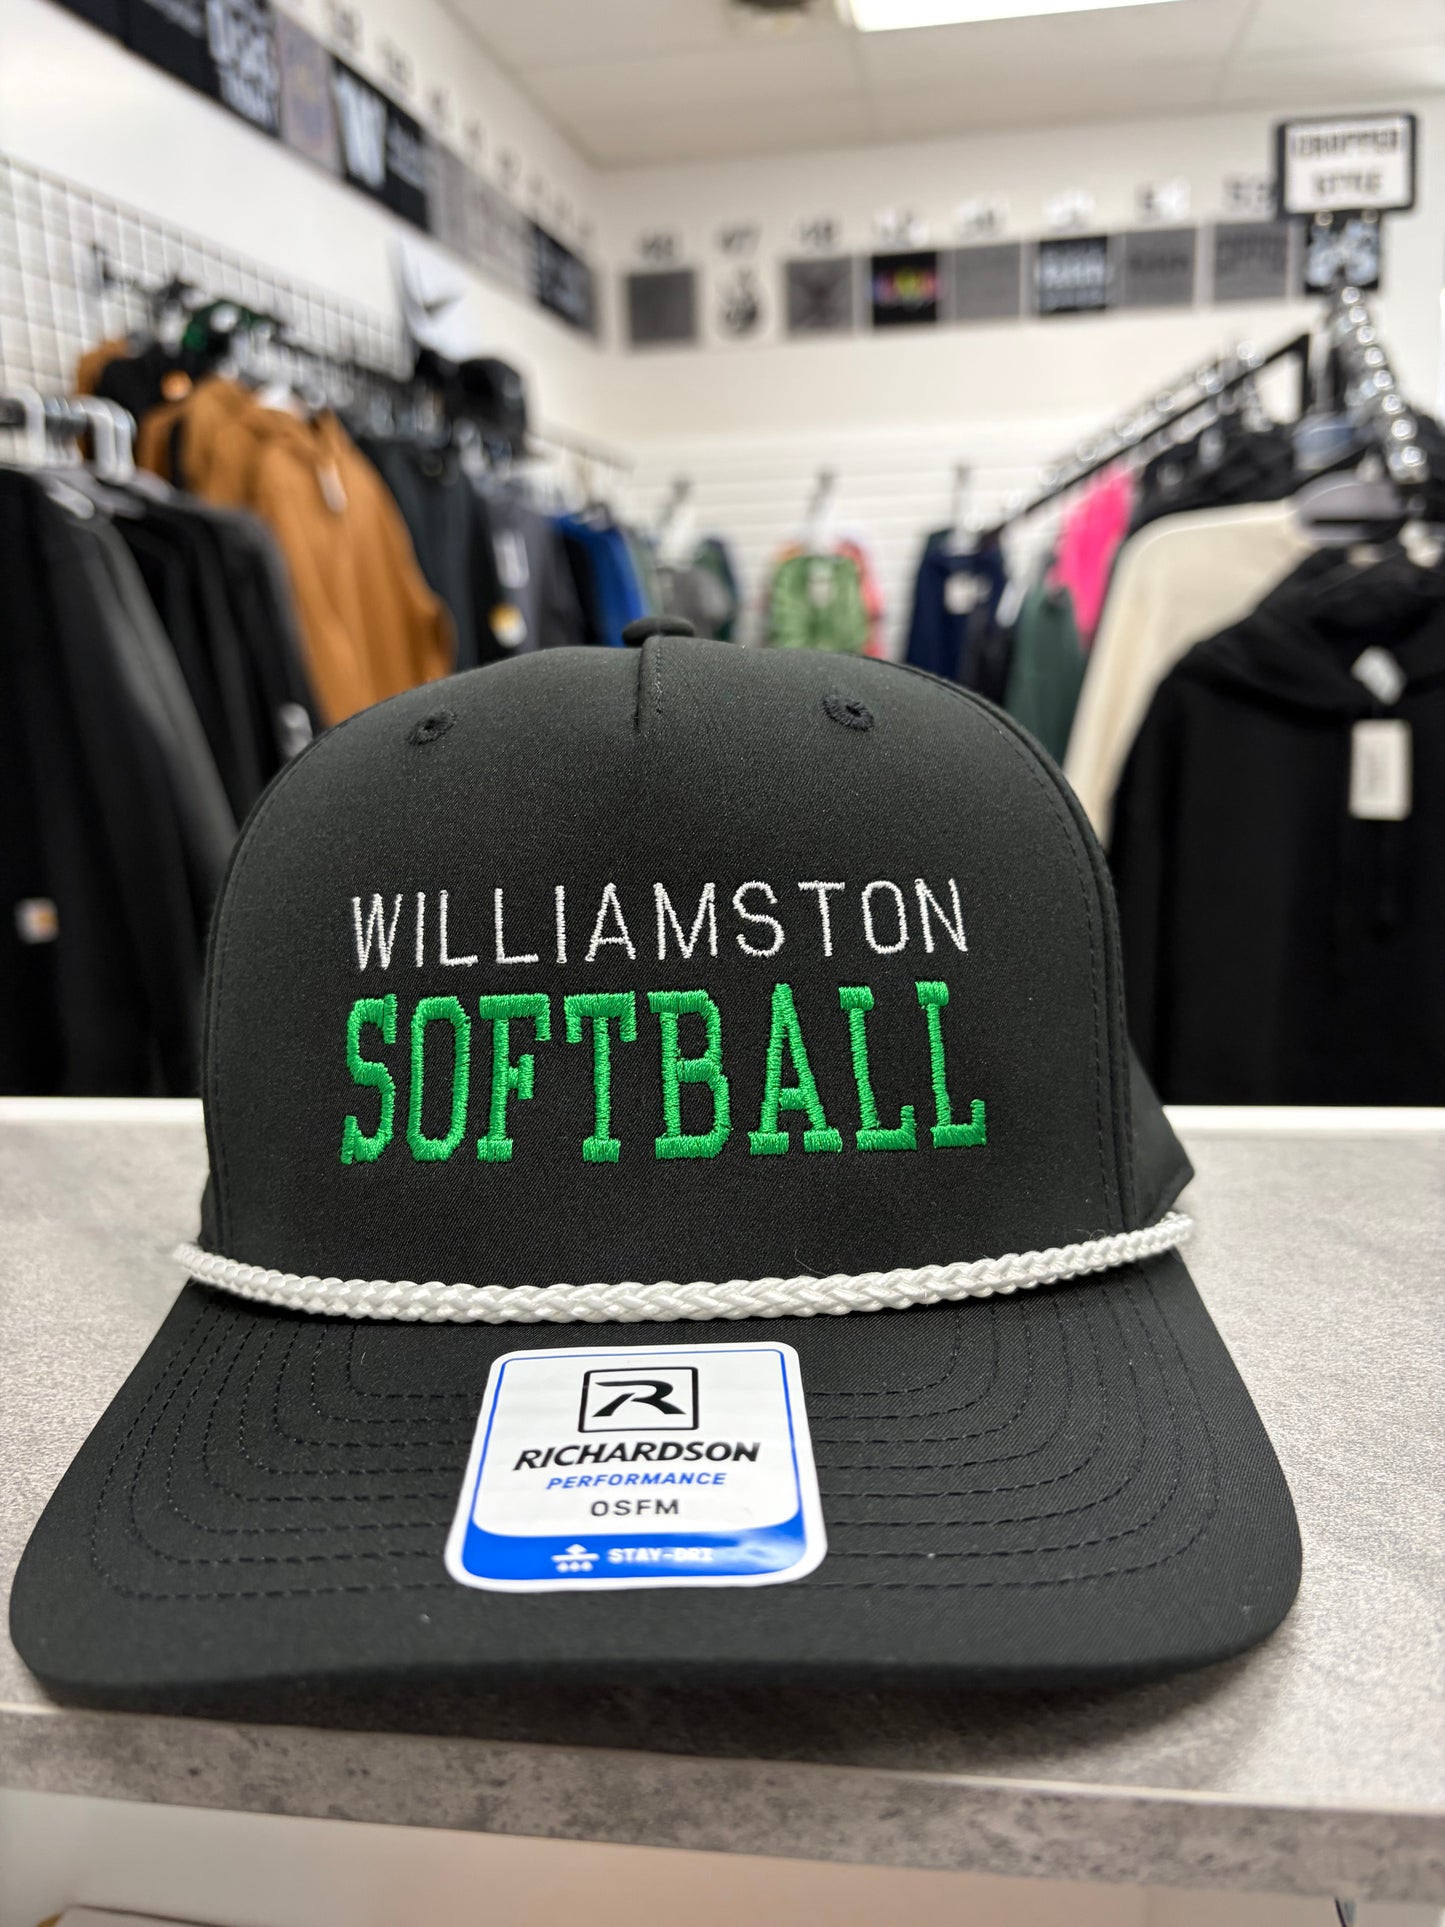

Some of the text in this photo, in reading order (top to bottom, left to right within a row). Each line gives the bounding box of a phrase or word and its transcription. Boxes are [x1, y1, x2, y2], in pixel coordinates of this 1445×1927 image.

[351, 879, 968, 971] WILLIAMSTON
[340, 981, 987, 1165] SOFTBALL
[513, 1440, 761, 1471] RICHARDSON
[545, 1472, 726, 1490] PERFORMANCE
[590, 1499, 679, 1517] OSFM
